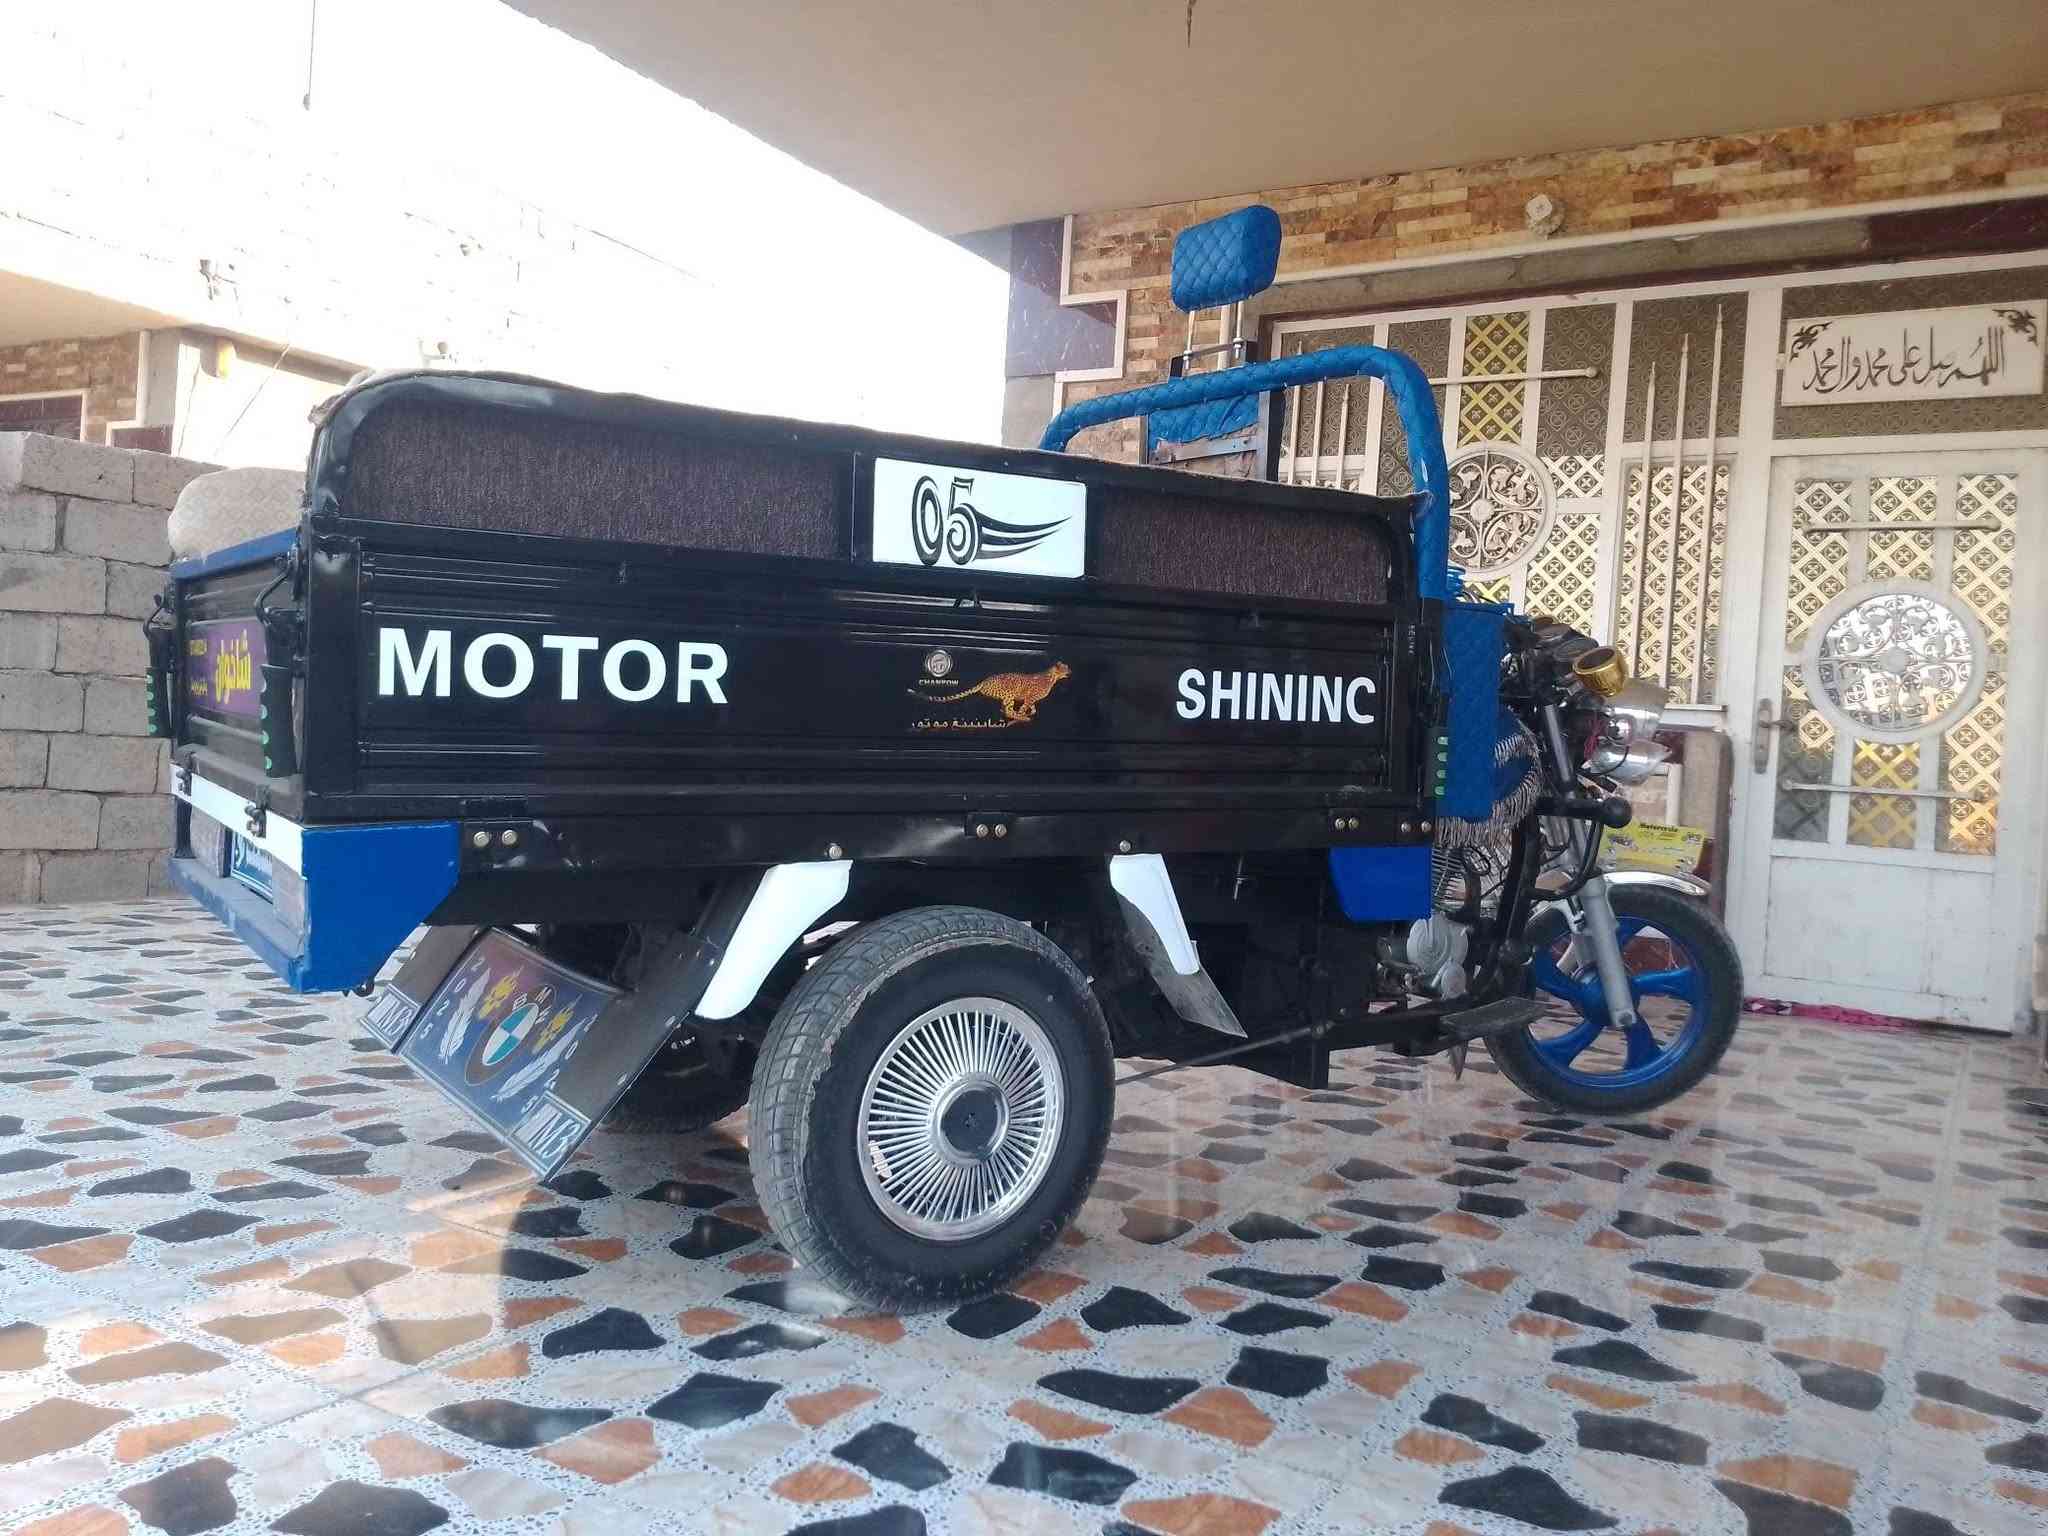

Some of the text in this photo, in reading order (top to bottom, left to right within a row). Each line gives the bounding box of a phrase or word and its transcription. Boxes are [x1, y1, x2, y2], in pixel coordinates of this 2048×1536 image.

[1856, 348, 1889, 391] محمد
[1888, 328, 1922, 386] على
[911, 475, 981, 566] 05
[379, 627, 728, 704] MOTOR
